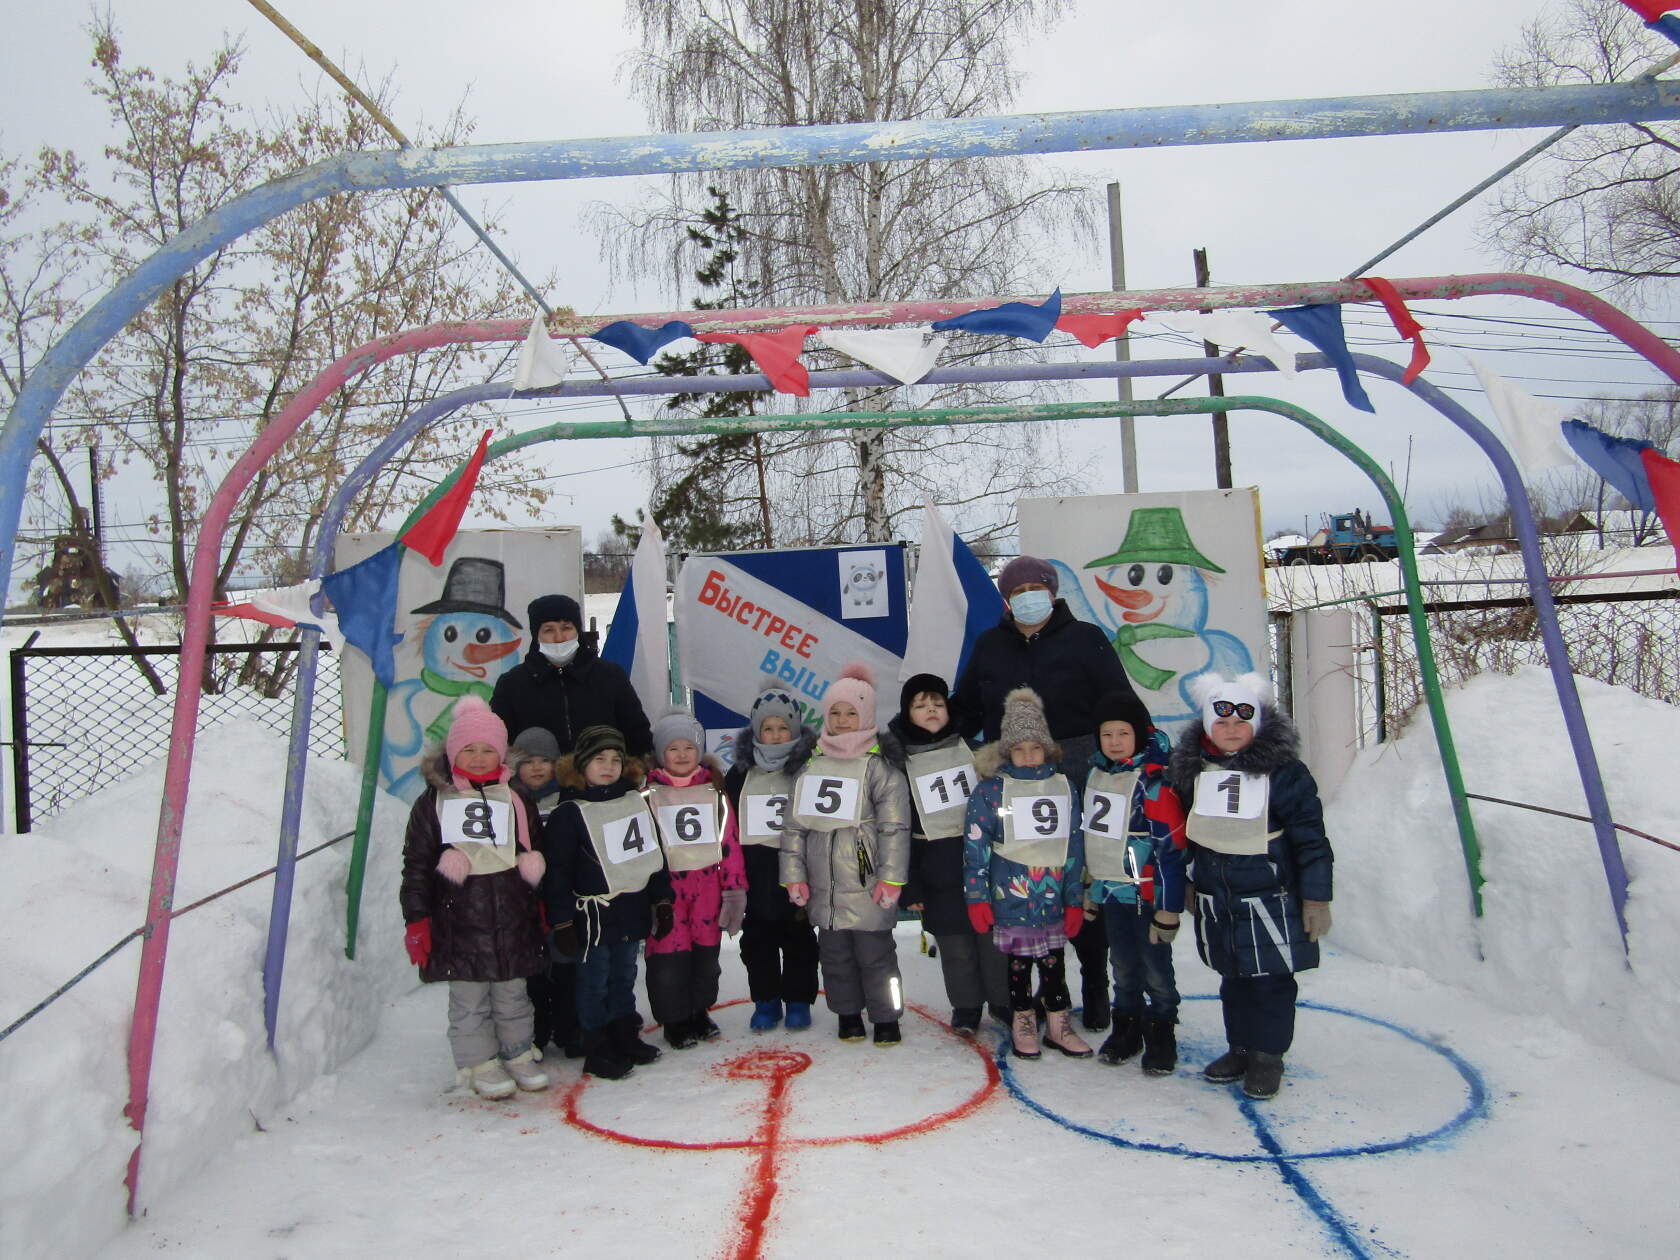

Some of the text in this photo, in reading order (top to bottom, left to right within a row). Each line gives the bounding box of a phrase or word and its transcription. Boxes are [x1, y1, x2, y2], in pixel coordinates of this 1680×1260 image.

[697, 570, 819, 659] БЫСТРЕЕ
[760, 649, 831, 701] ВЫШ
[814, 779, 843, 814] 5
[930, 770, 971, 804] 11
[1217, 774, 1241, 814] 1
[462, 801, 493, 839] 8
[675, 806, 702, 842] 6
[766, 797, 788, 831] 3
[1031, 798, 1058, 835] 9
[1089, 794, 1112, 833] 2
[622, 817, 644, 853] 4
